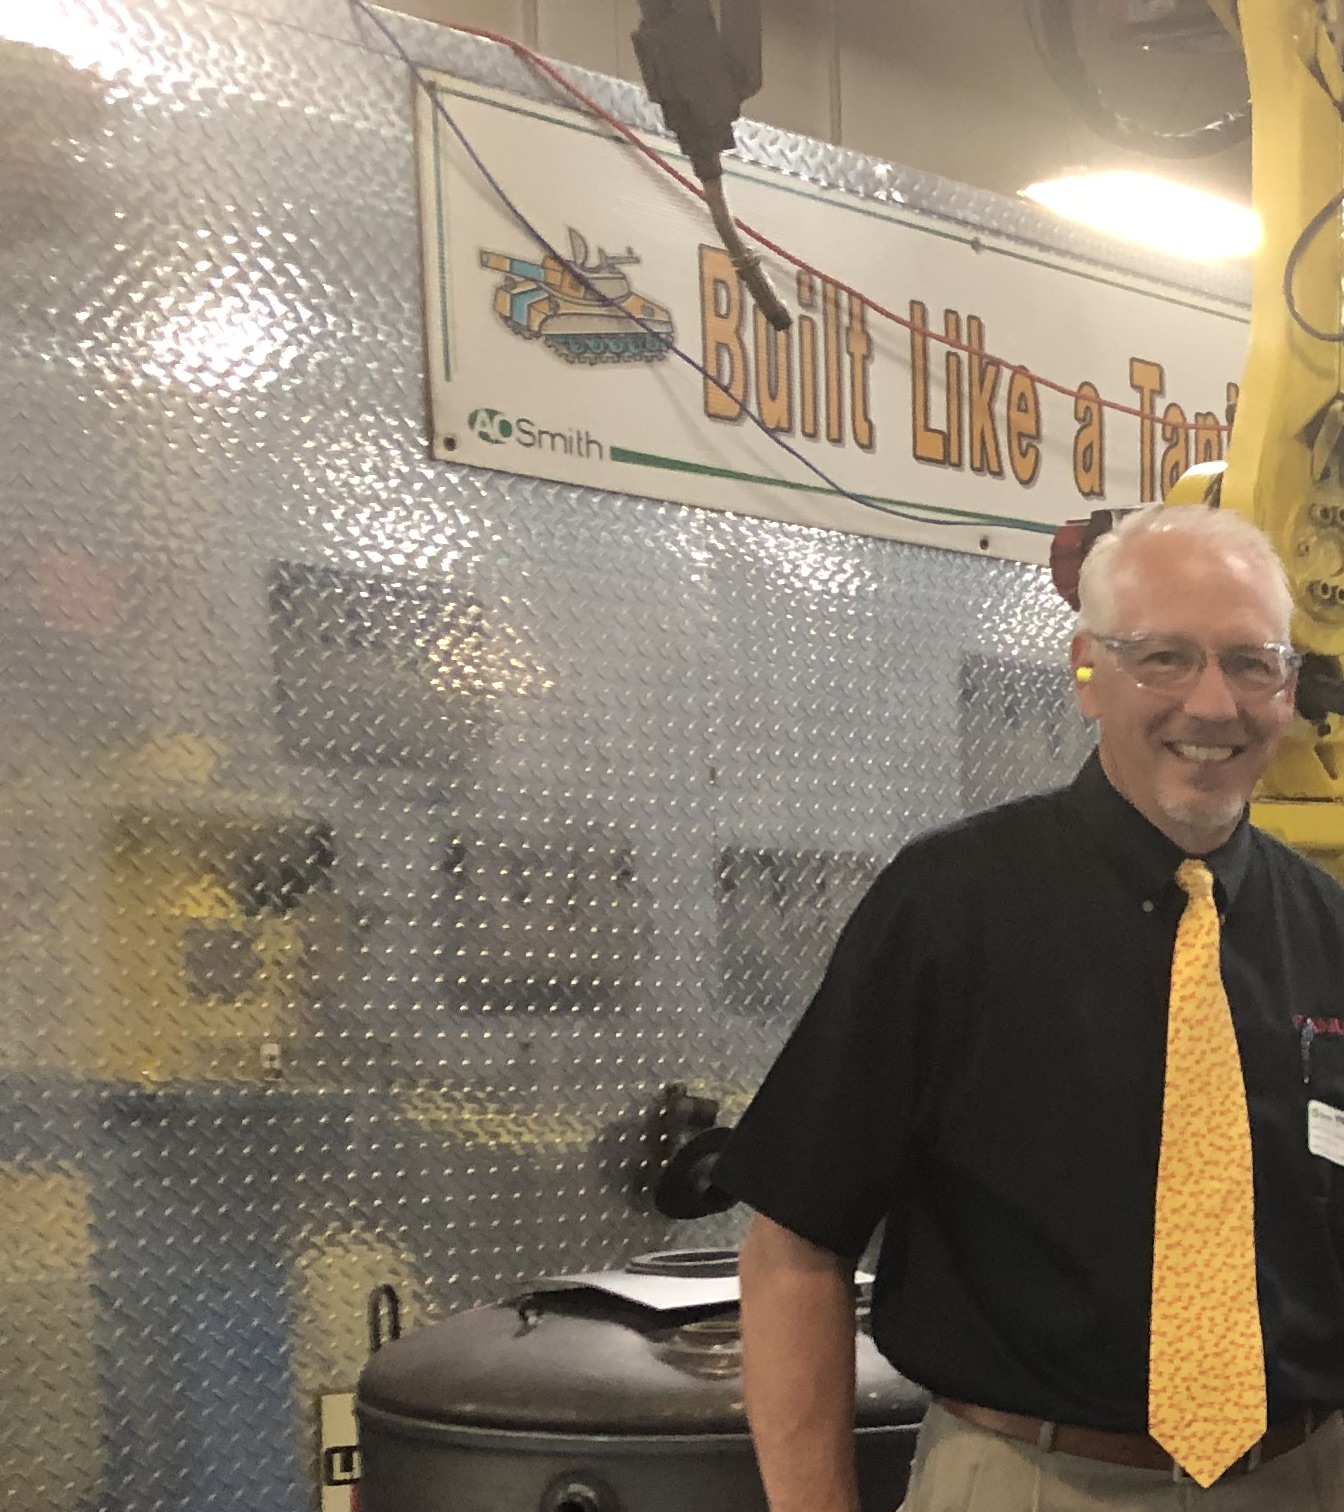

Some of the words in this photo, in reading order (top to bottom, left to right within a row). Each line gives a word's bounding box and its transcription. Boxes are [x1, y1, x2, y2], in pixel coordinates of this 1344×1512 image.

[698, 243, 876, 452] Built
[910, 299, 1041, 488] Like
[1072, 381, 1105, 499] a
[1129, 356, 1240, 503] Tan
